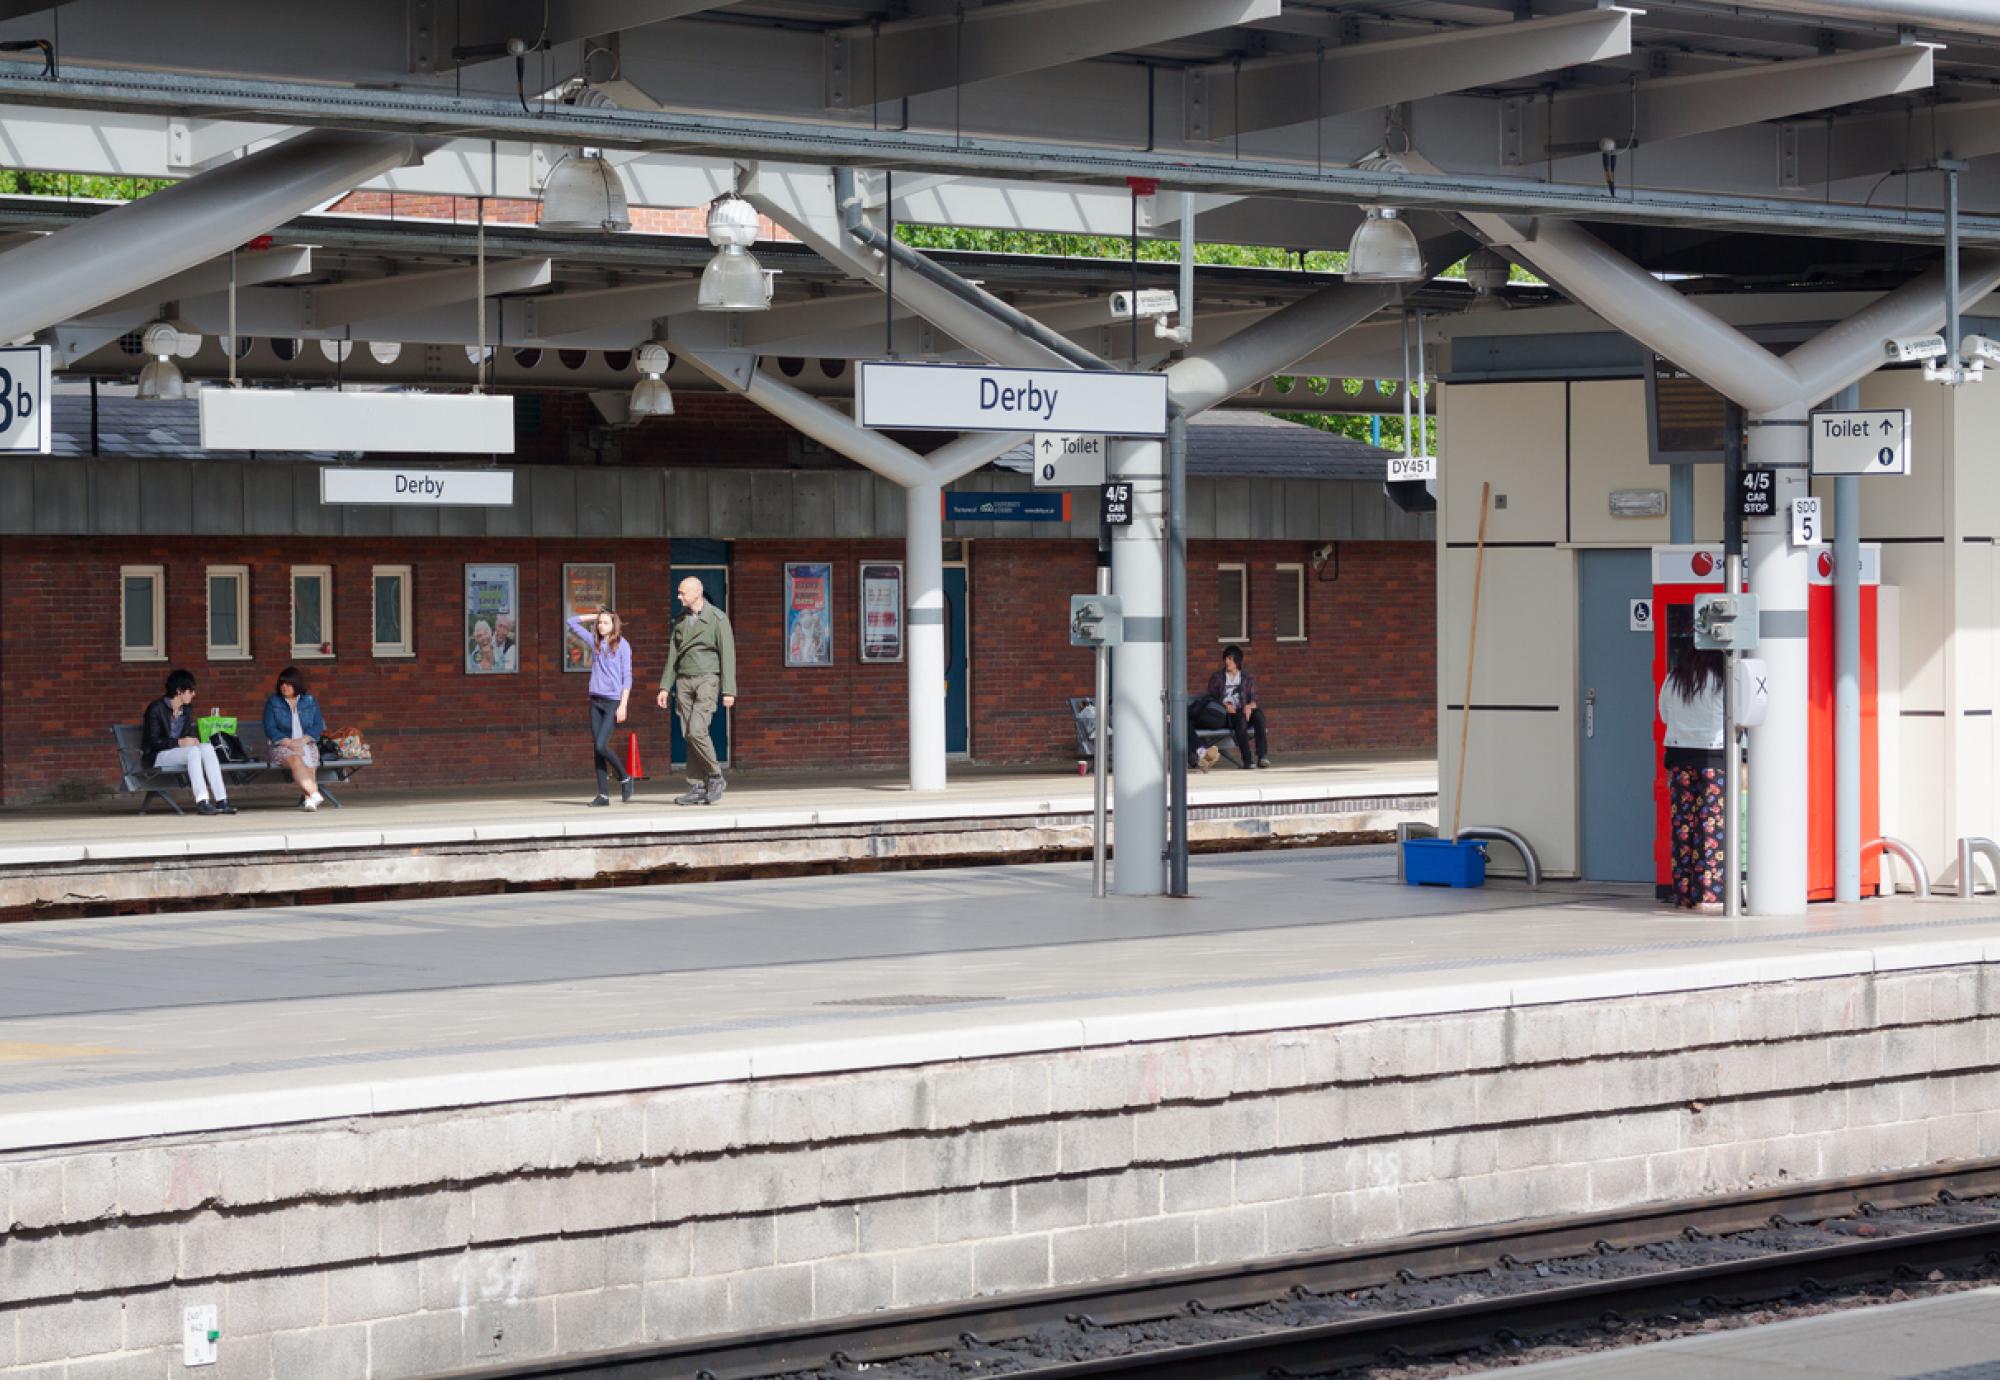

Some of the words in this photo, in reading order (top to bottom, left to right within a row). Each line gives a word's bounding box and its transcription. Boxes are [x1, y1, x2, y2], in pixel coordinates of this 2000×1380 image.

[980, 377, 1058, 420] Derby
[1822, 419, 1870, 437] Toilet
[1061, 437, 1099, 454] Toilet
[1392, 460, 1430, 474] DY451
[395, 474, 445, 499] Derby
[1743, 471, 1770, 490] 4/5
[1105, 486, 1128, 502] 4/5
[1746, 492, 1767, 502] CAR
[1108, 503, 1125, 512] CAR
[1744, 503, 1769, 513] STOP
[1796, 501, 1817, 513] SDO
[1106, 513, 1127, 523] STOP
[1802, 517, 1813, 541] 5
[1755, 676, 1768, 696] X
